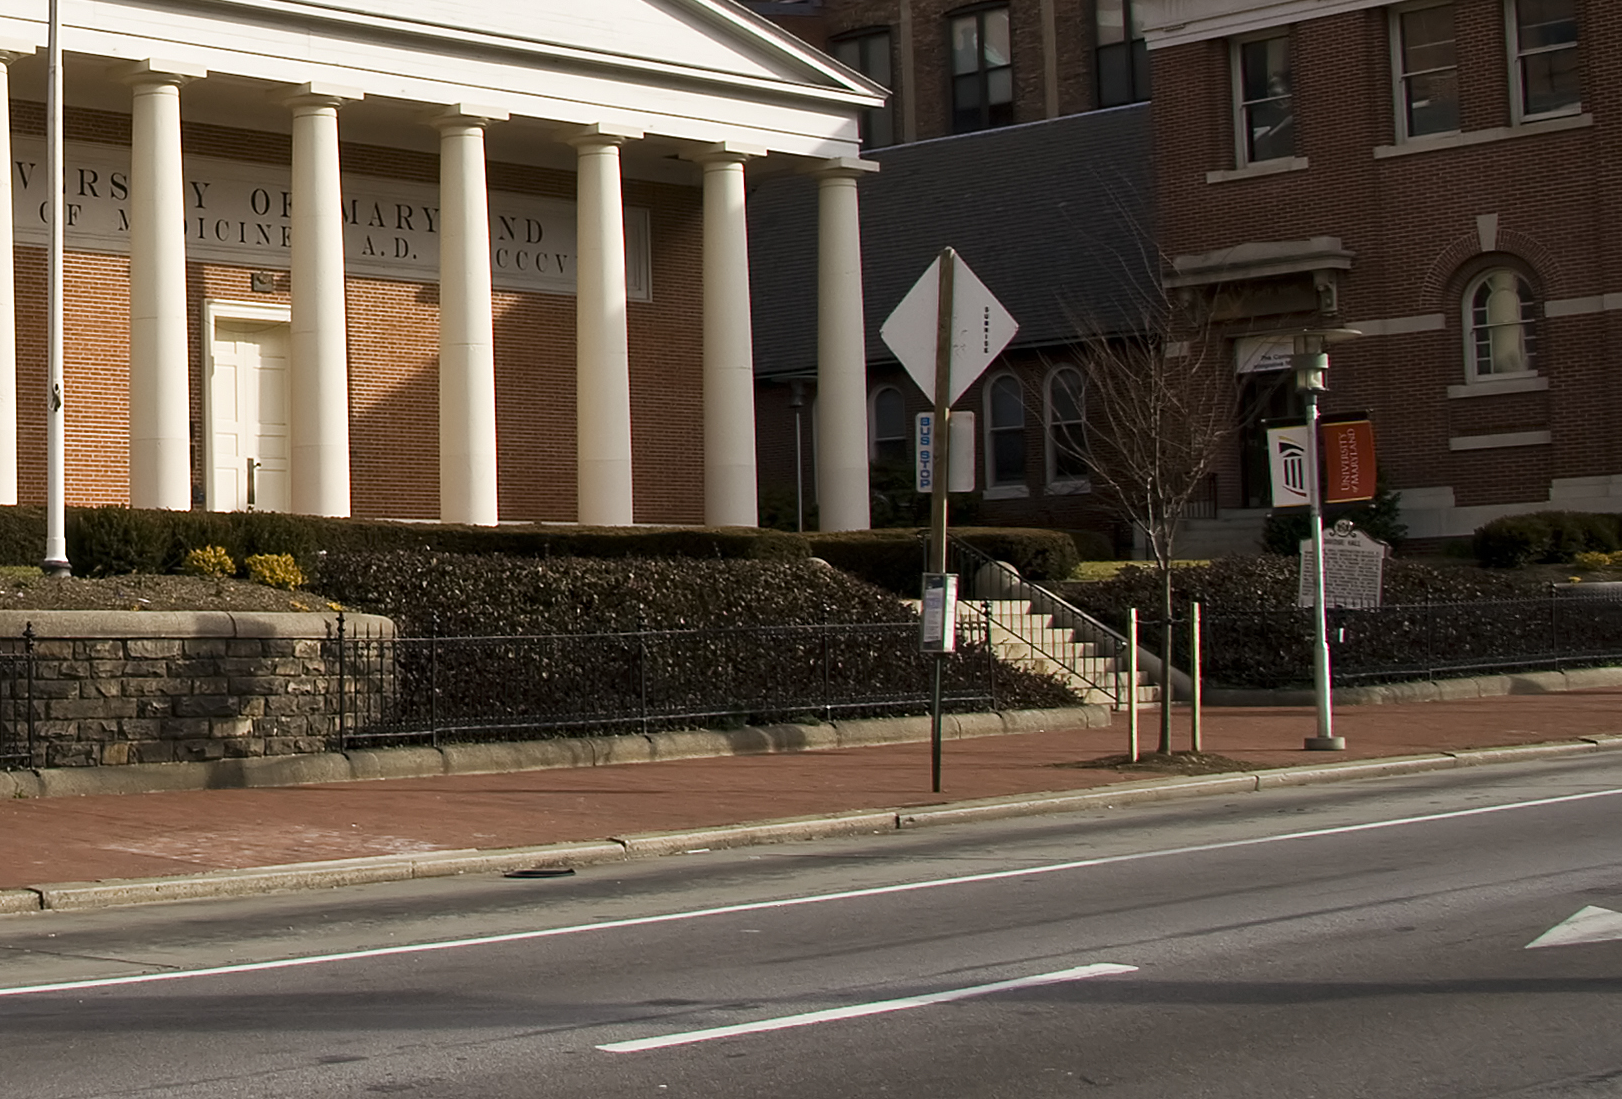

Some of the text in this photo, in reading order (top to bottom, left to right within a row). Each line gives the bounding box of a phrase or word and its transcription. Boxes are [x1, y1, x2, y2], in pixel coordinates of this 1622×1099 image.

[342, 199, 544, 244] MARYND
[362, 235, 417, 260] A.D.
[920, 417, 931, 446] BUS
[920, 450, 931, 489] STOP
[1339, 432, 1350, 491] UNIVERSITY
[1346, 428, 1359, 484] MARYLAND
